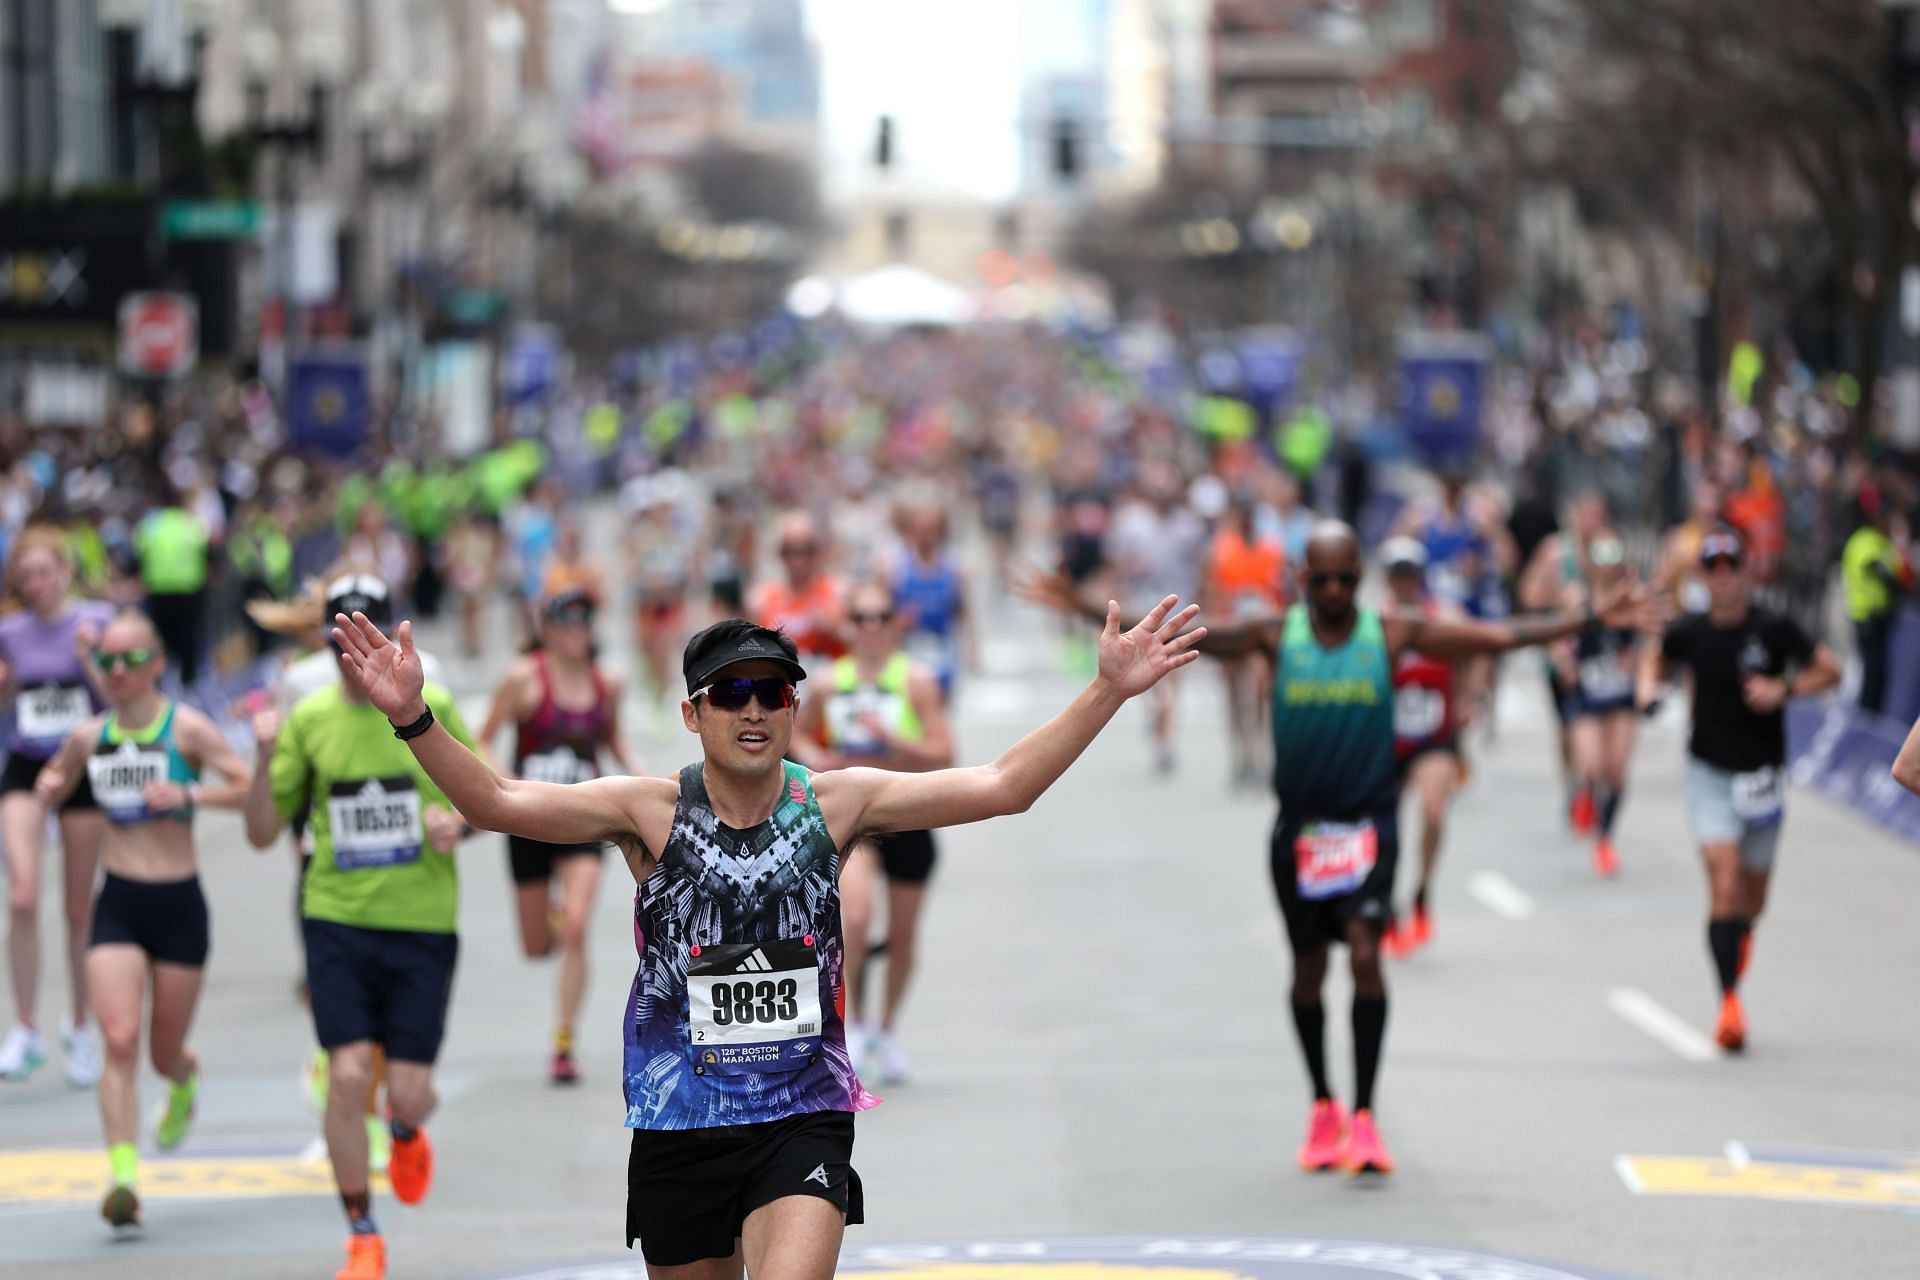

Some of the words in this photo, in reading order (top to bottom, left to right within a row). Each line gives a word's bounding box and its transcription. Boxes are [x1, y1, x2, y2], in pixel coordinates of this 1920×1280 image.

[711, 978, 798, 1026] 9833
[697, 1031, 705, 1041] 2
[742, 1045, 779, 1055] BOSTON
[722, 1053, 779, 1064] MARATHON
